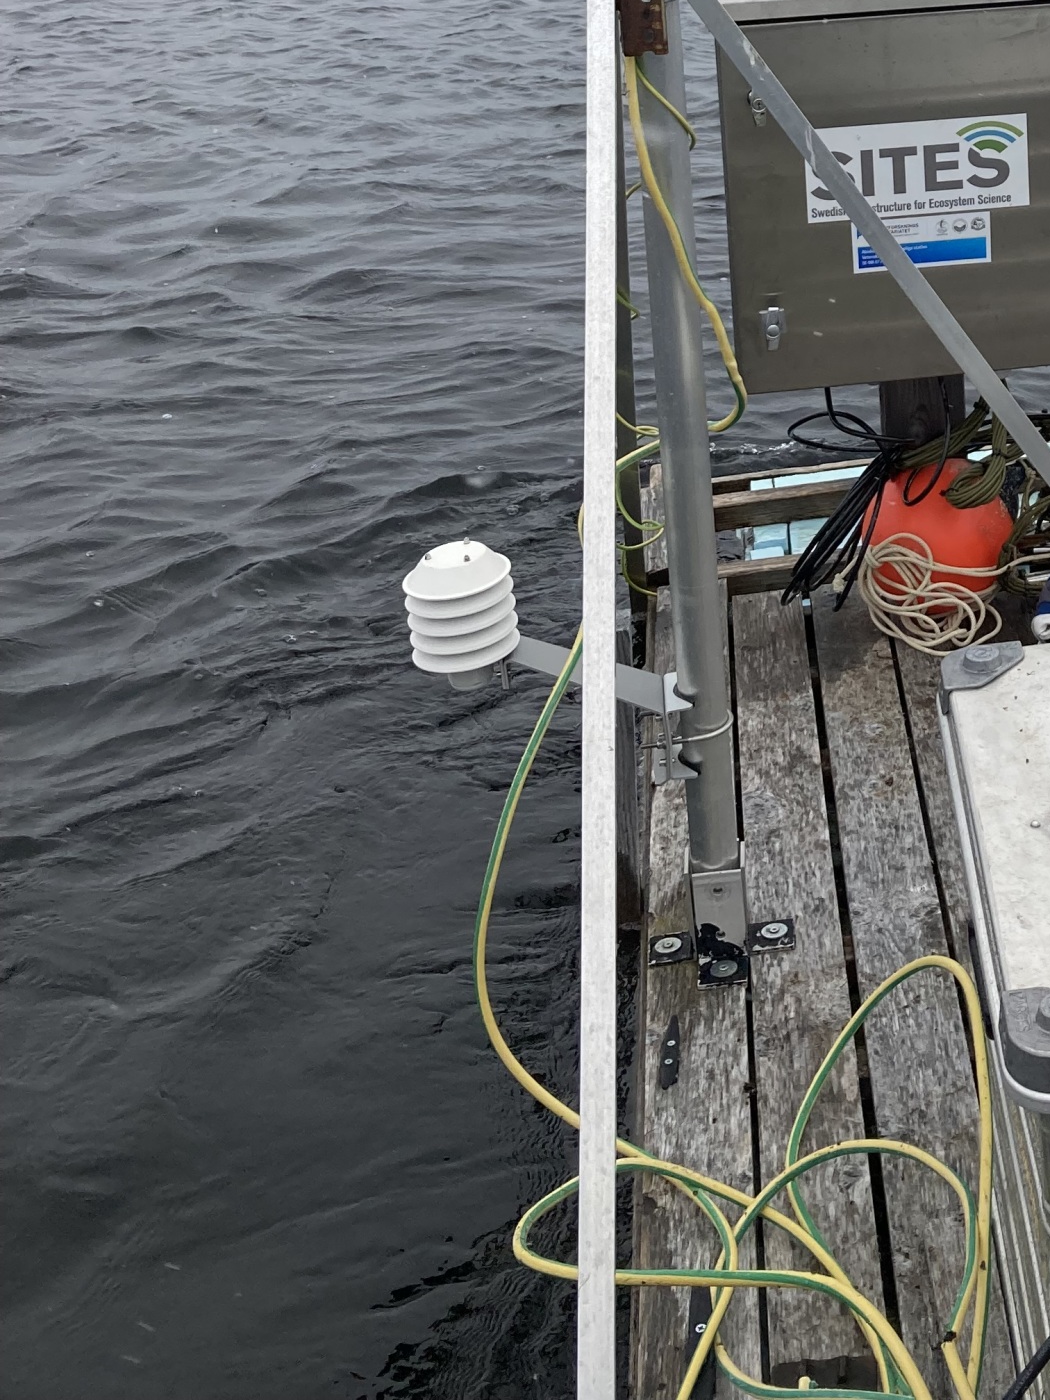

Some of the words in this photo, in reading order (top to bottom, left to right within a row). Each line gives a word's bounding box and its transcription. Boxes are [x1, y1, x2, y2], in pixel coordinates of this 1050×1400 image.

[872, 200, 911, 213] structure
[914, 199, 926, 210] for
[929, 196, 975, 210] Ecosystem
[977, 194, 1012, 205] Science
